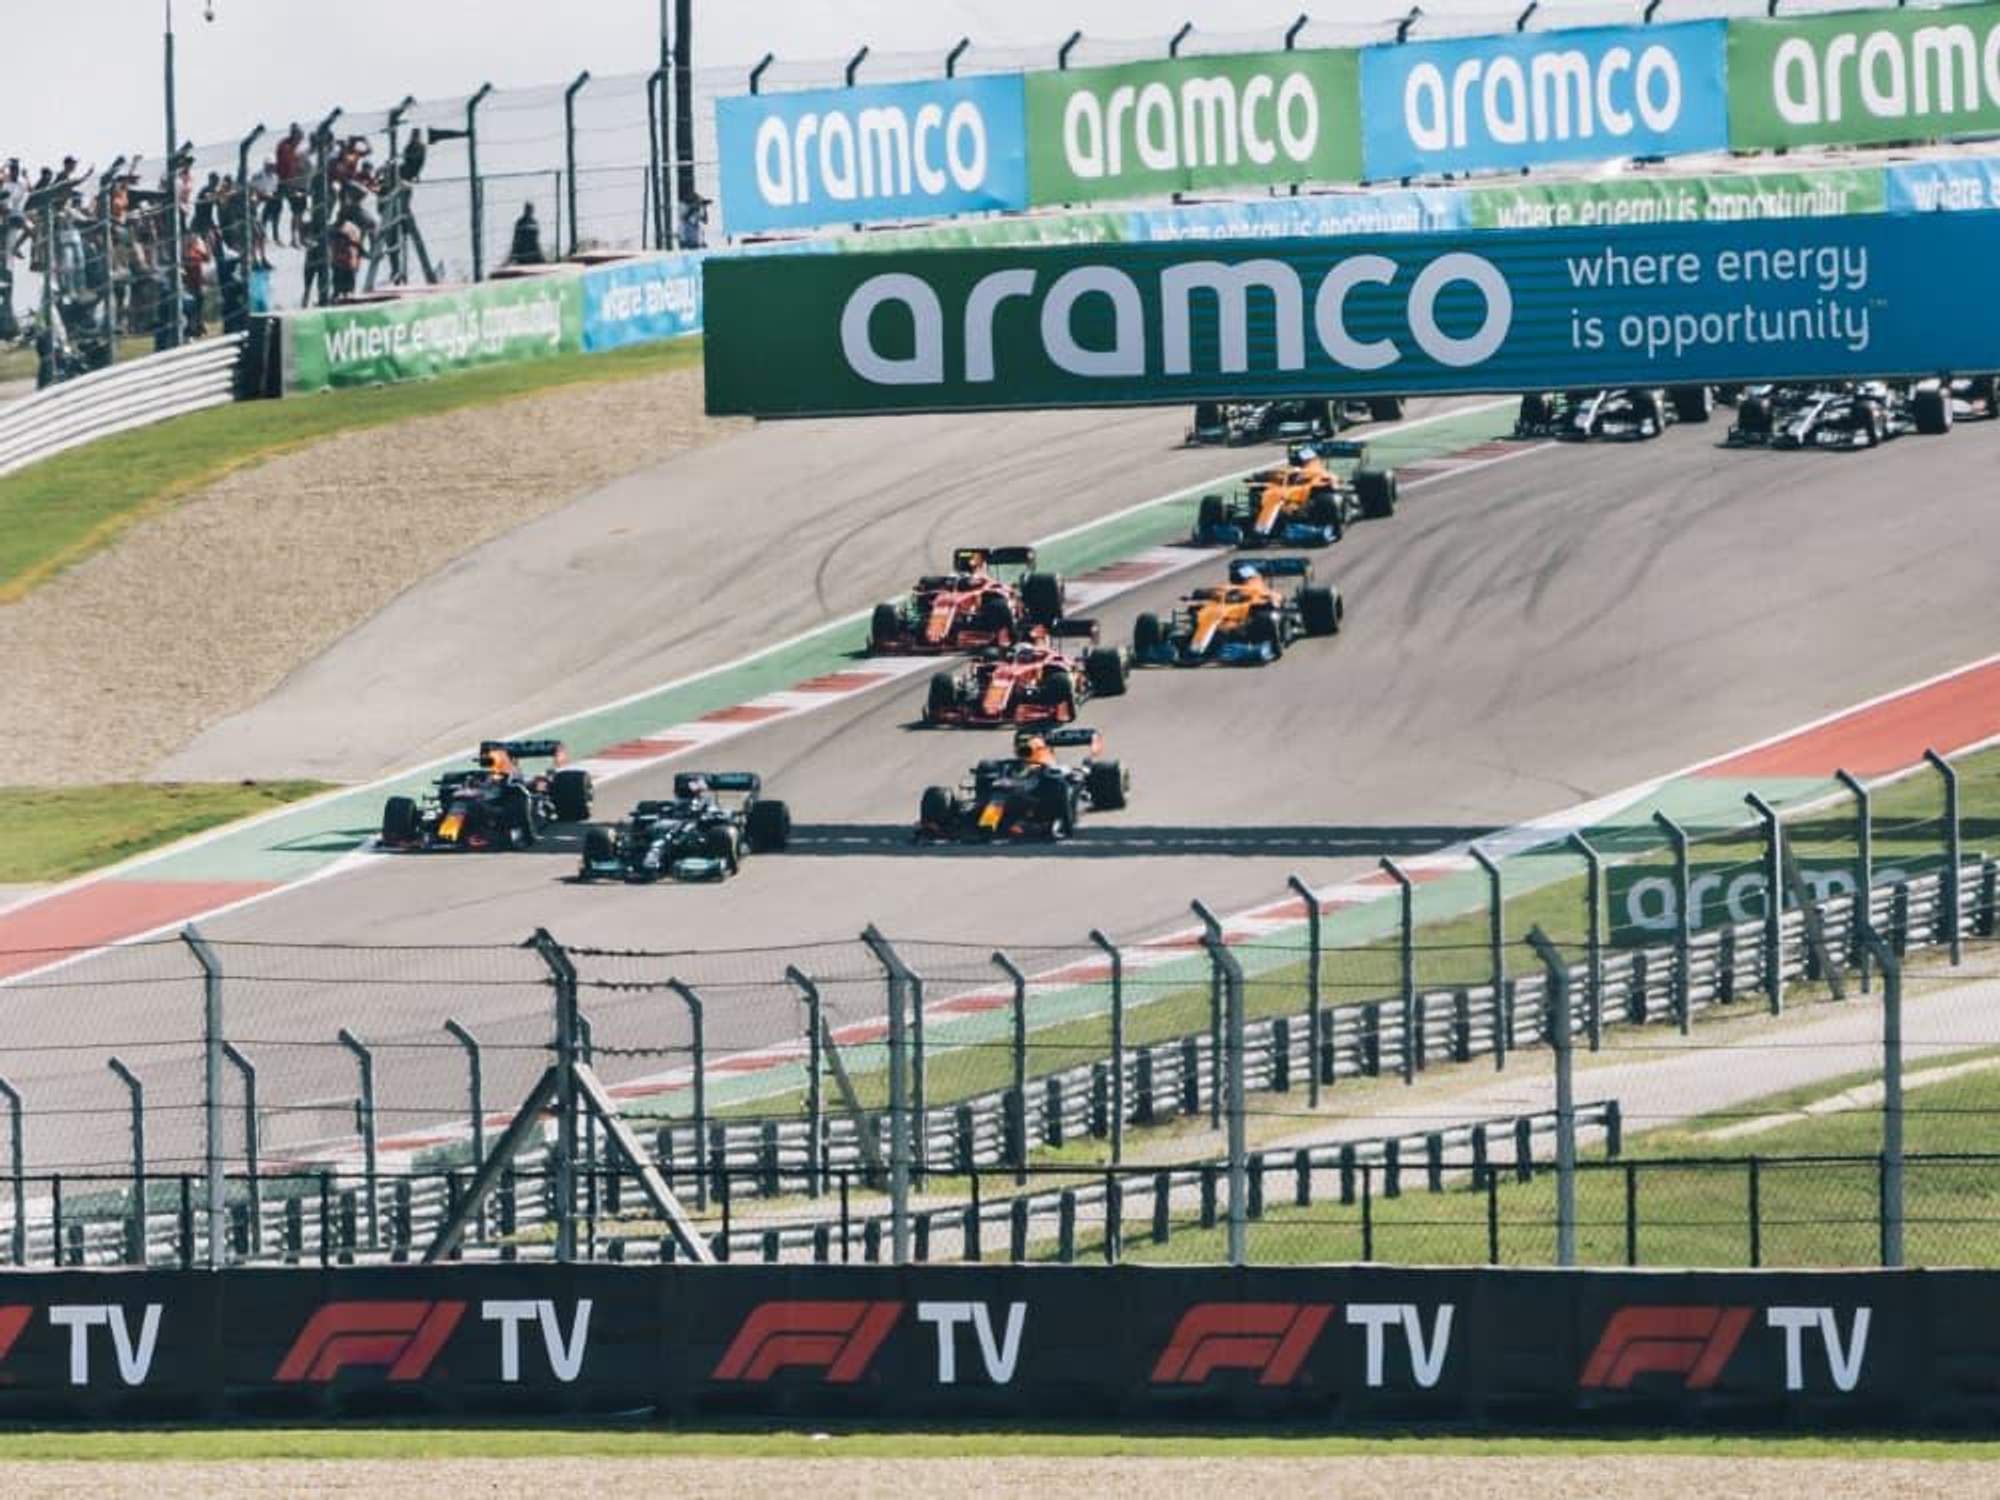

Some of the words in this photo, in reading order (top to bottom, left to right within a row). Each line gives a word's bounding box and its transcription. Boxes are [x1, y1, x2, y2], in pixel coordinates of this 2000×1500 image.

[1063, 72, 1319, 178] aramco
[1404, 45, 1681, 151] aramco
[755, 100, 987, 206] aramco
[1566, 246, 1700, 287] where
[1716, 246, 1868, 291] energy
[325, 319, 408, 365] where
[839, 252, 1512, 385] aramco
[1571, 308, 1604, 348] is
[1619, 298, 1868, 359] opportunity
[49, 1304, 163, 1385] TV
[275, 1302, 466, 1380] F1
[481, 1299, 592, 1382] TV
[712, 1302, 903, 1380] F1
[917, 1301, 1027, 1383] TV
[1150, 1304, 1334, 1386] F1
[1346, 1304, 1454, 1387] TV
[1580, 1307, 1753, 1388] F1
[1767, 1307, 1871, 1391] TV
